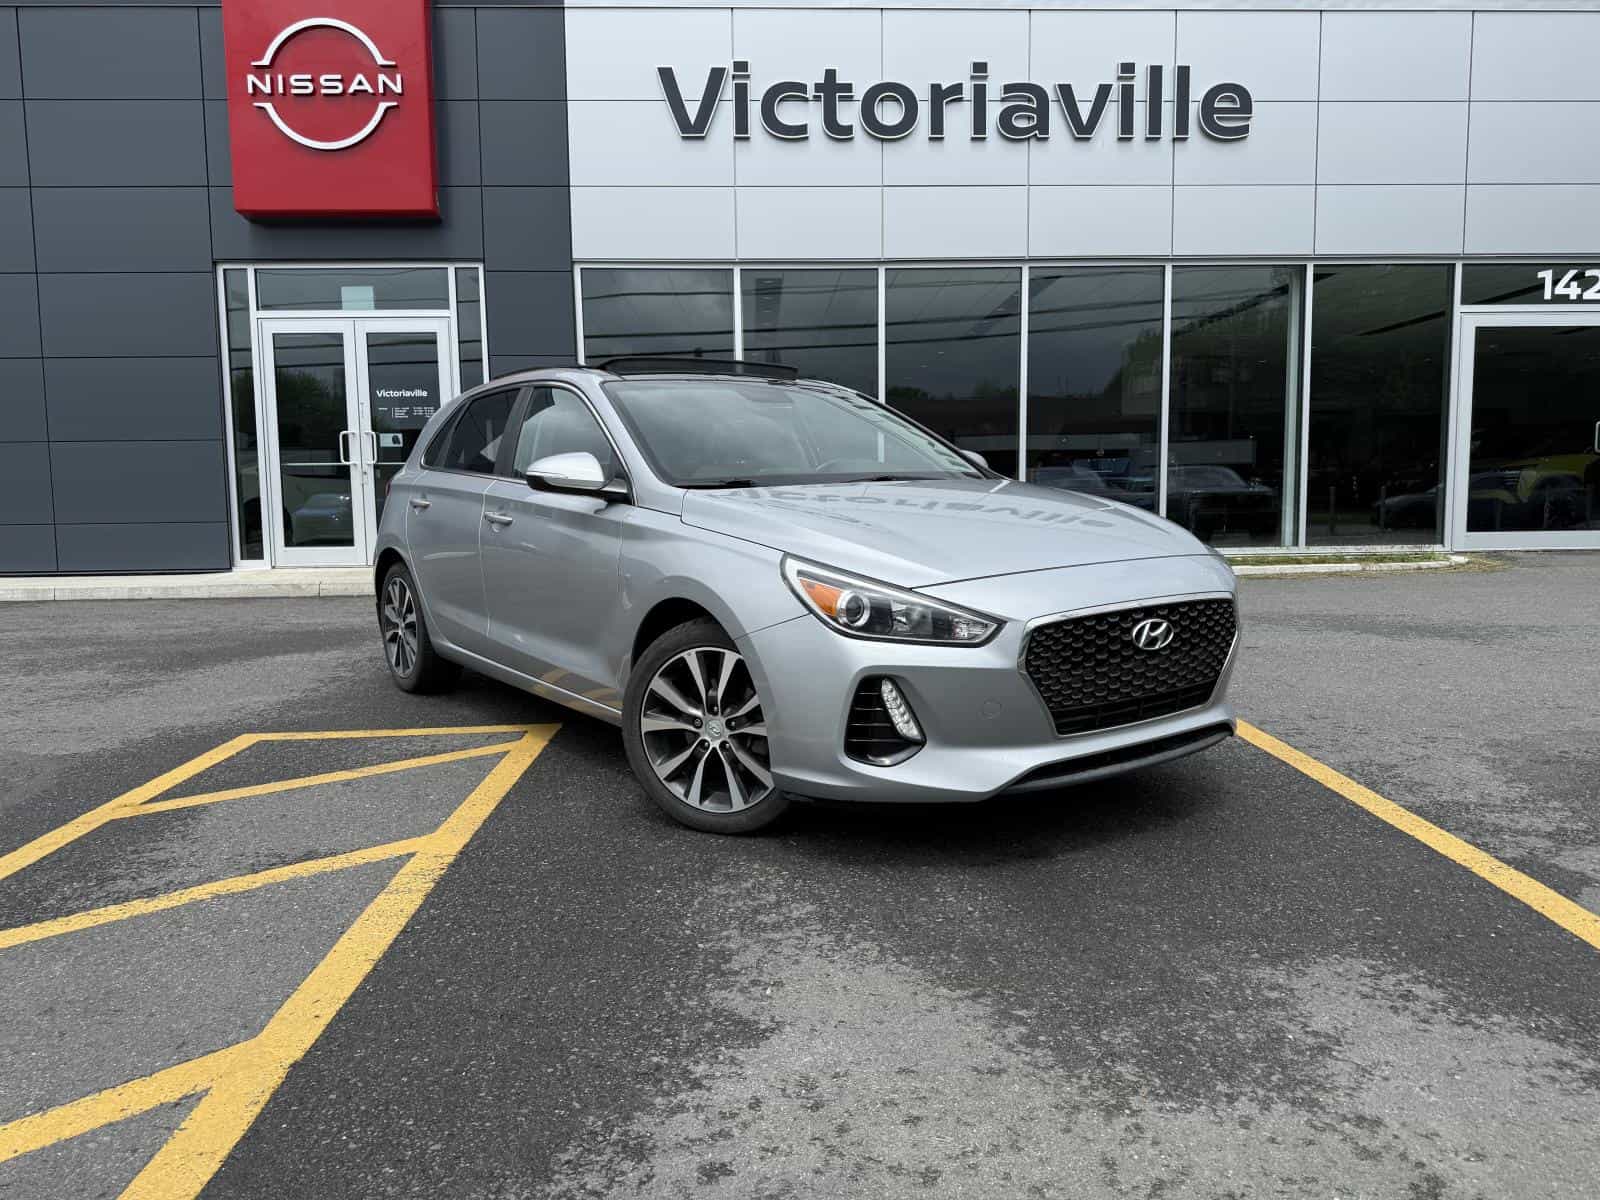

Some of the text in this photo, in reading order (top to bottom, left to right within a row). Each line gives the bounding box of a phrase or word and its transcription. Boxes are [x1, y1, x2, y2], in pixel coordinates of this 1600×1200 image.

[246, 73, 403, 95] NISSAN
[656, 60, 1254, 142] Victoriaville
[376, 389, 428, 397] Victoriaville
